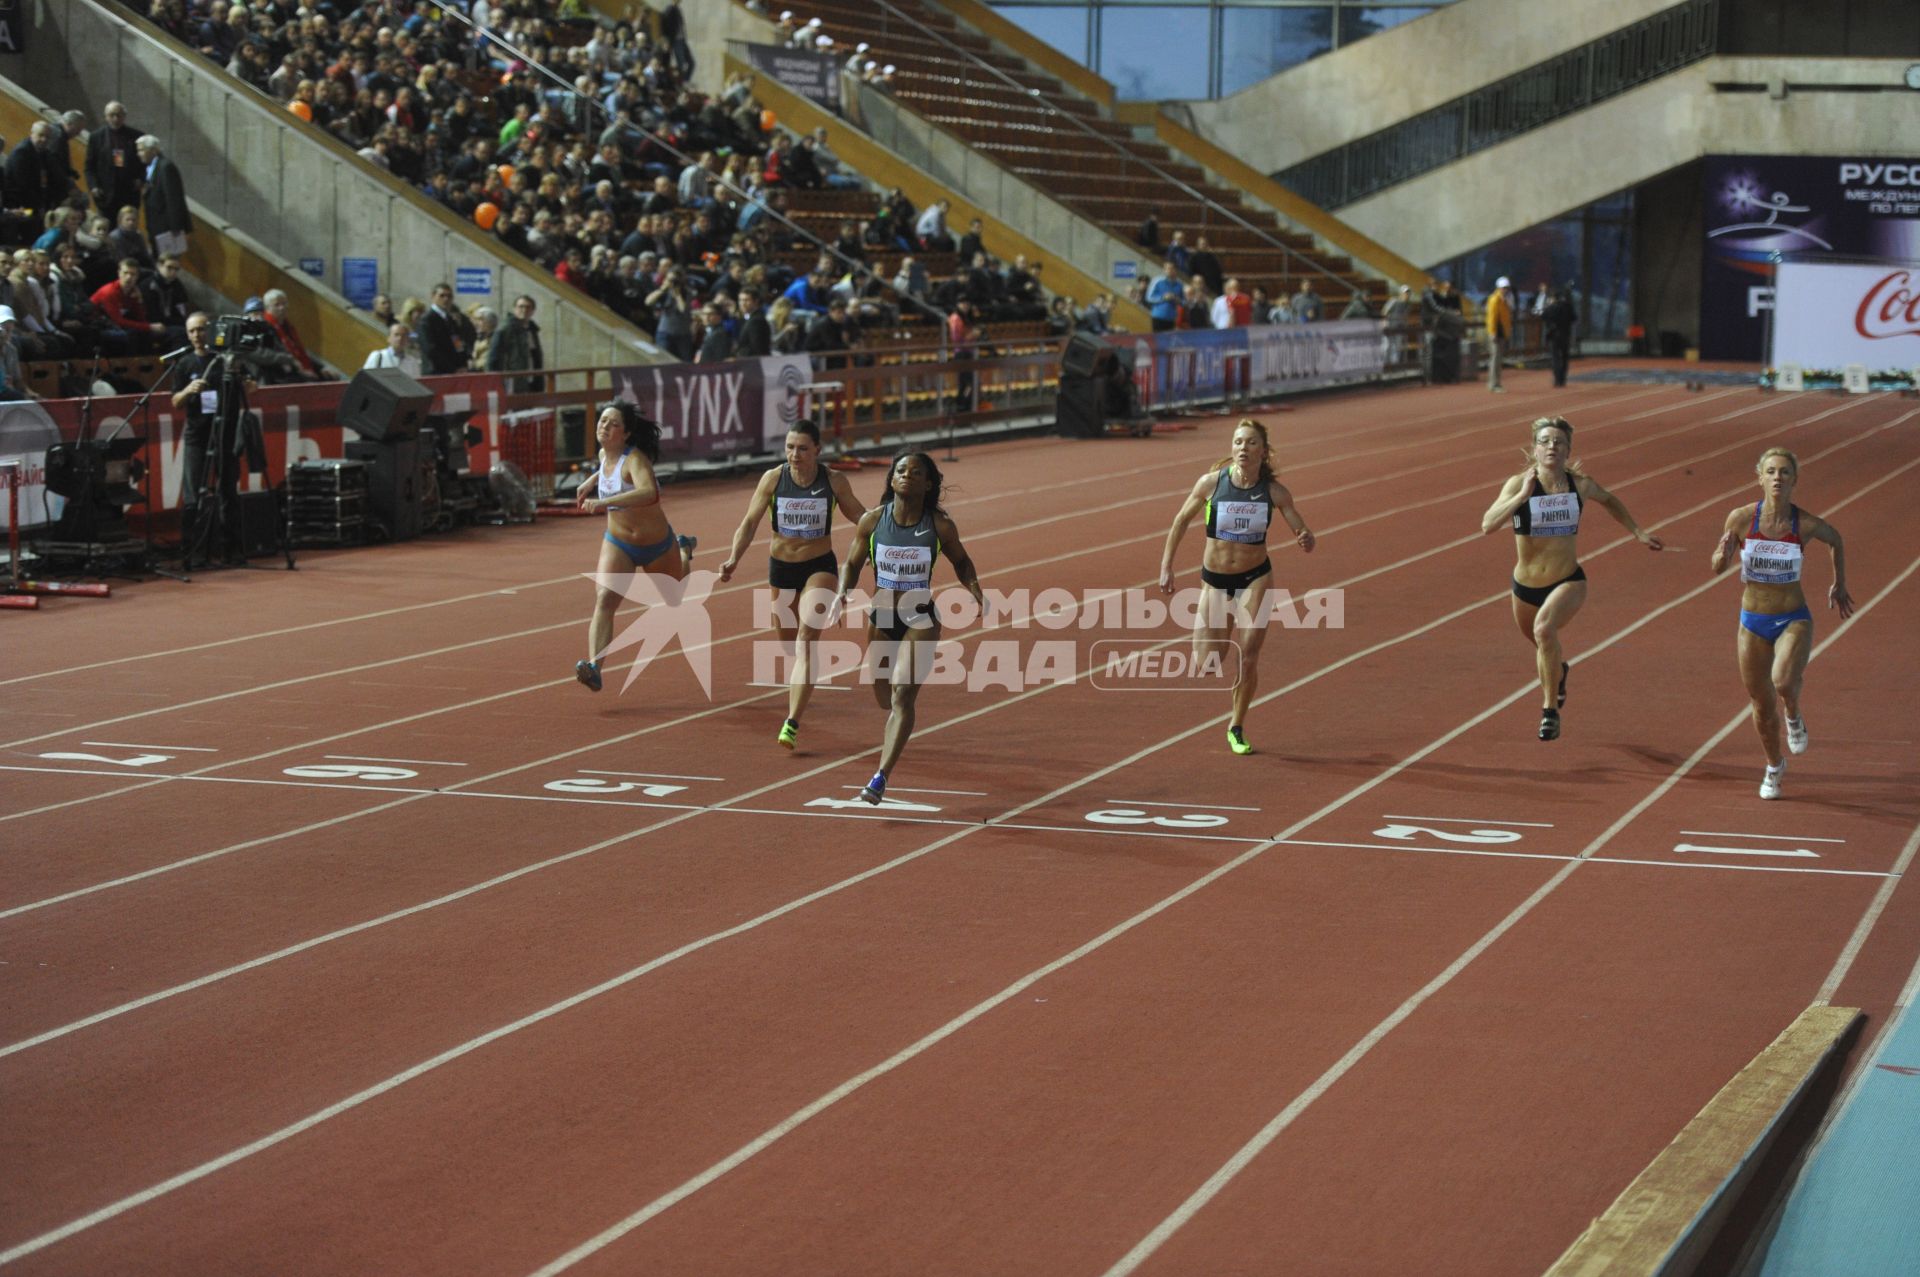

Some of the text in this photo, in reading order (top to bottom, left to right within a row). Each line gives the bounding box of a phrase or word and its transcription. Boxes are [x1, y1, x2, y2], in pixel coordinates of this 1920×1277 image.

[652, 368, 744, 440] LYNX
[783, 513, 820, 525] POLYAKOVA
[1234, 517, 1251, 529] STUY
[898, 563, 926, 576] MILAMA
[1750, 557, 1793, 570] YARUSHKINA
[1085, 808, 1230, 828] 3
[1373, 823, 1522, 844] 2
[1673, 842, 1820, 858] 1
